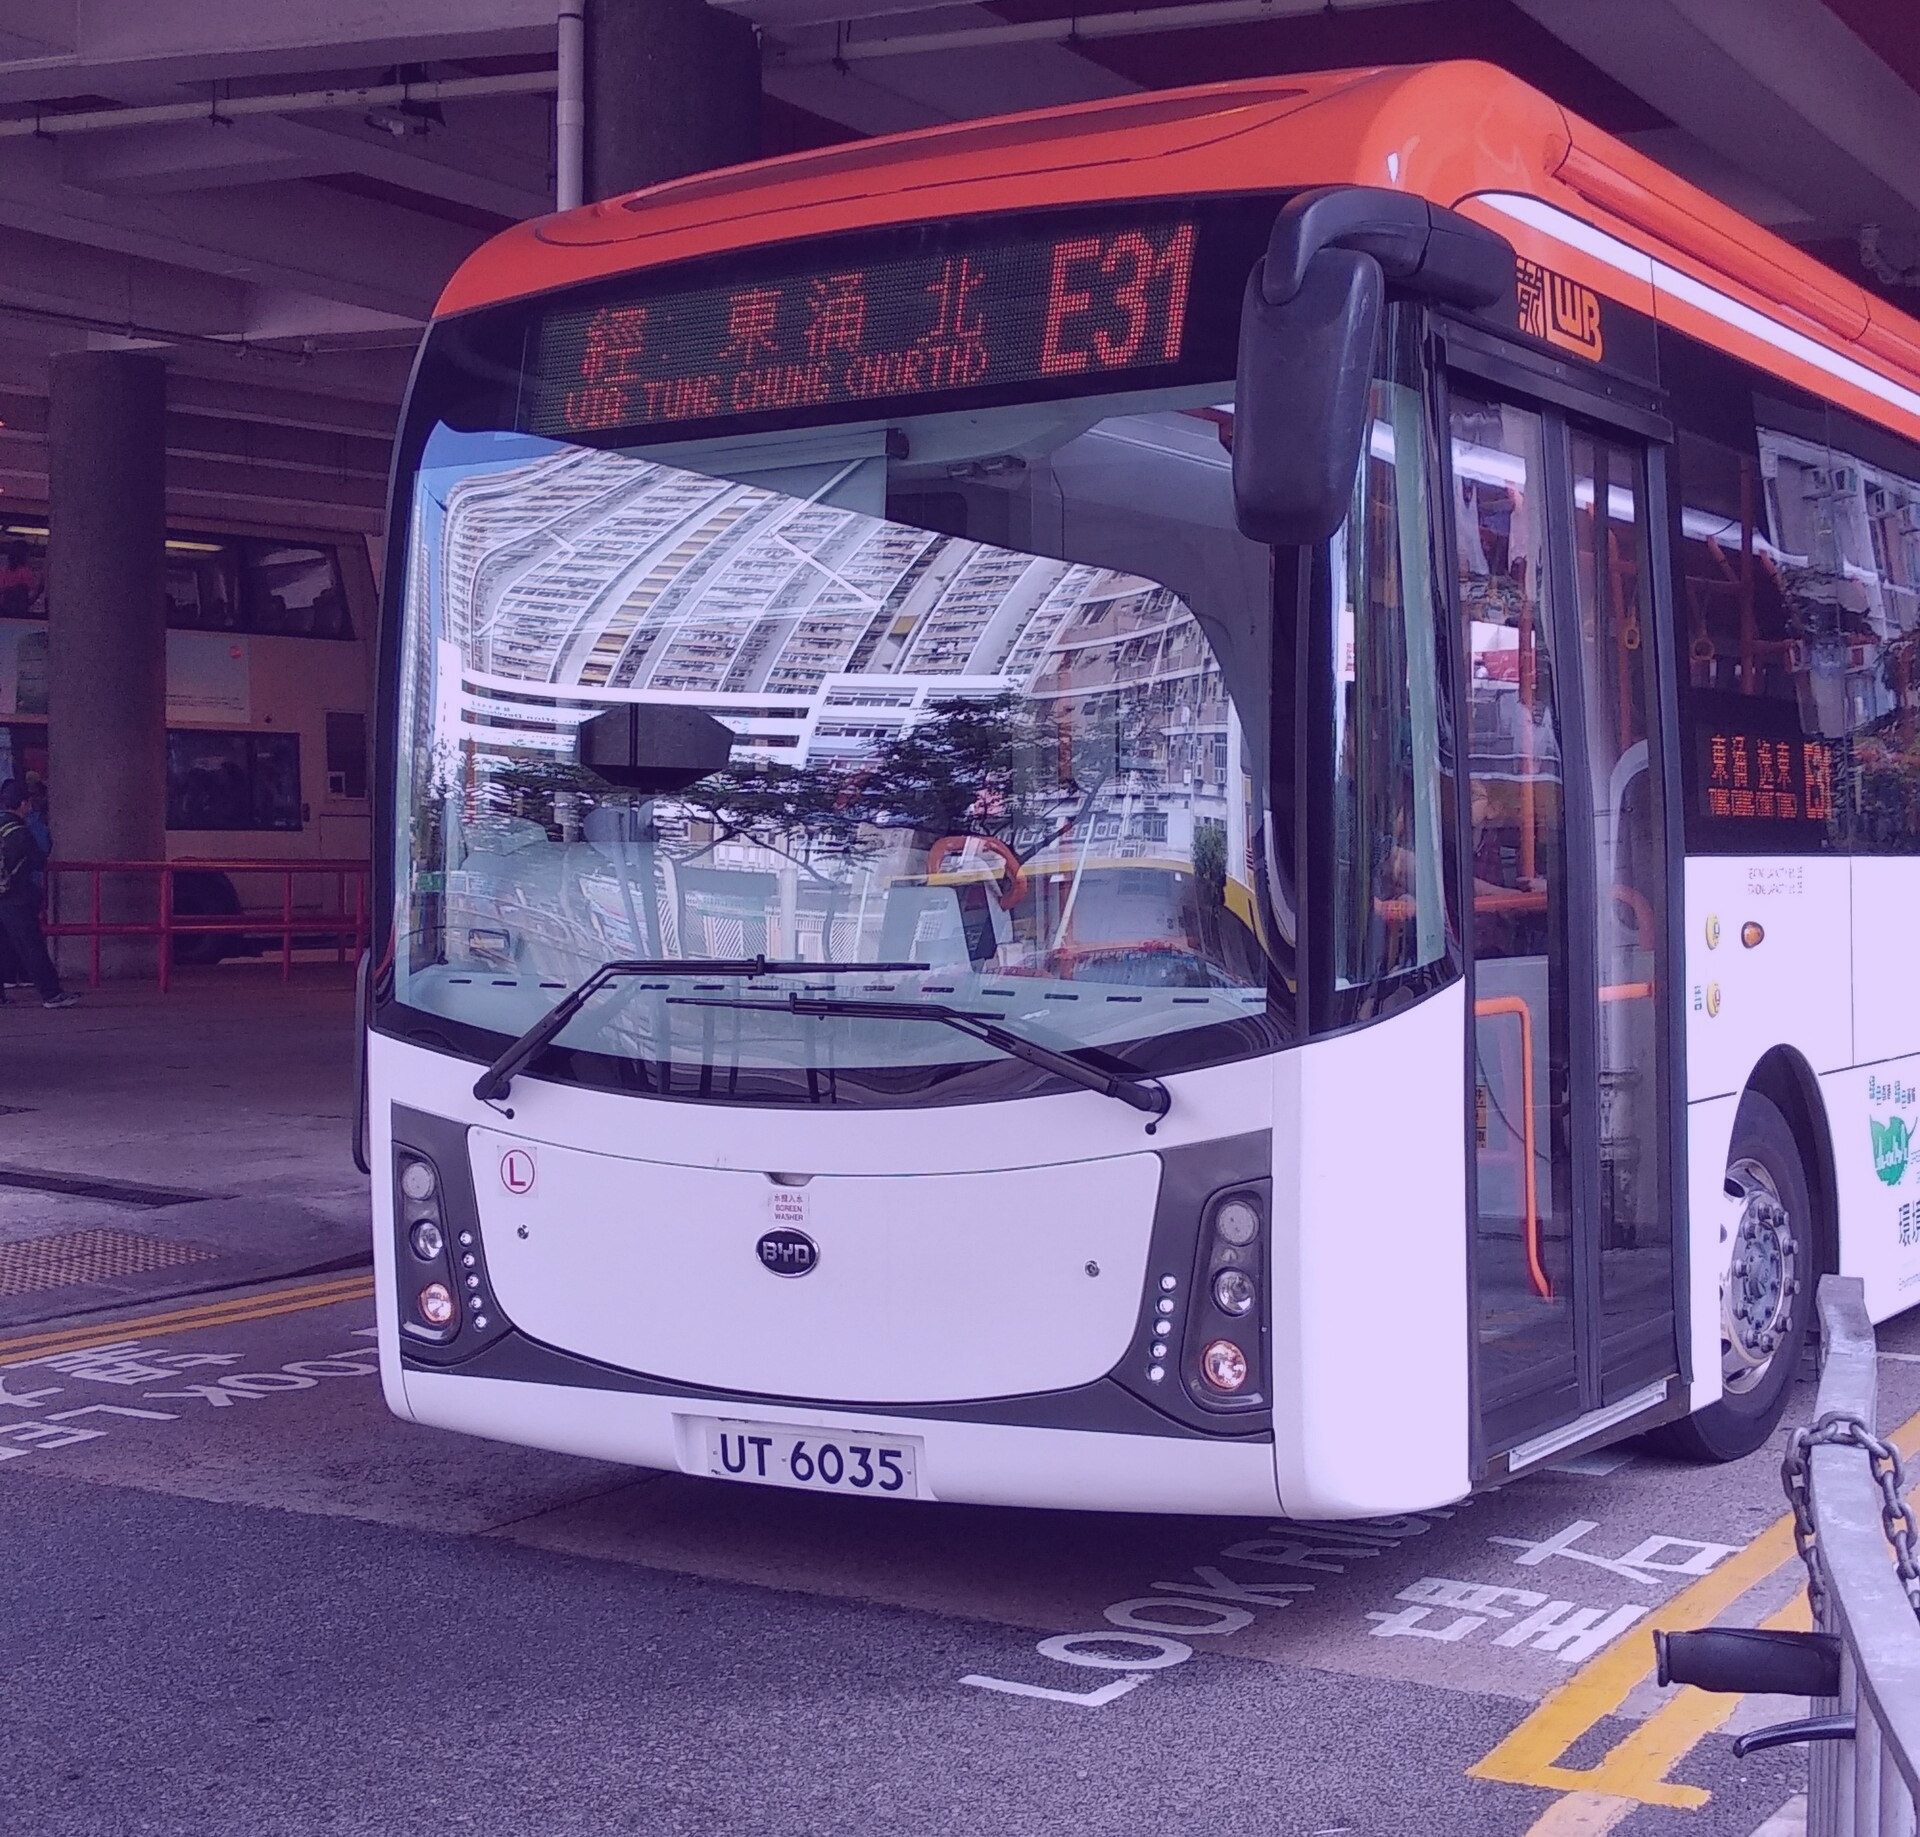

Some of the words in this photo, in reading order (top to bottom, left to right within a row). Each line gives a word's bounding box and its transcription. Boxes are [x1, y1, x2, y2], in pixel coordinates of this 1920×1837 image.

[1040, 223, 1194, 375] E31
[1543, 269, 1604, 364] LWB
[643, 373, 722, 421] TUNG
[732, 360, 832, 412] CHUNG
[509, 1156, 528, 1187] L
[774, 1212, 804, 1222] WASHER
[775, 1204, 803, 1213] SCREEN
[761, 1240, 811, 1264] BYD
[720, 1433, 773, 1476] UT
[789, 1440, 904, 1492] 6035
[957, 1565, 1316, 1708] LOOK
